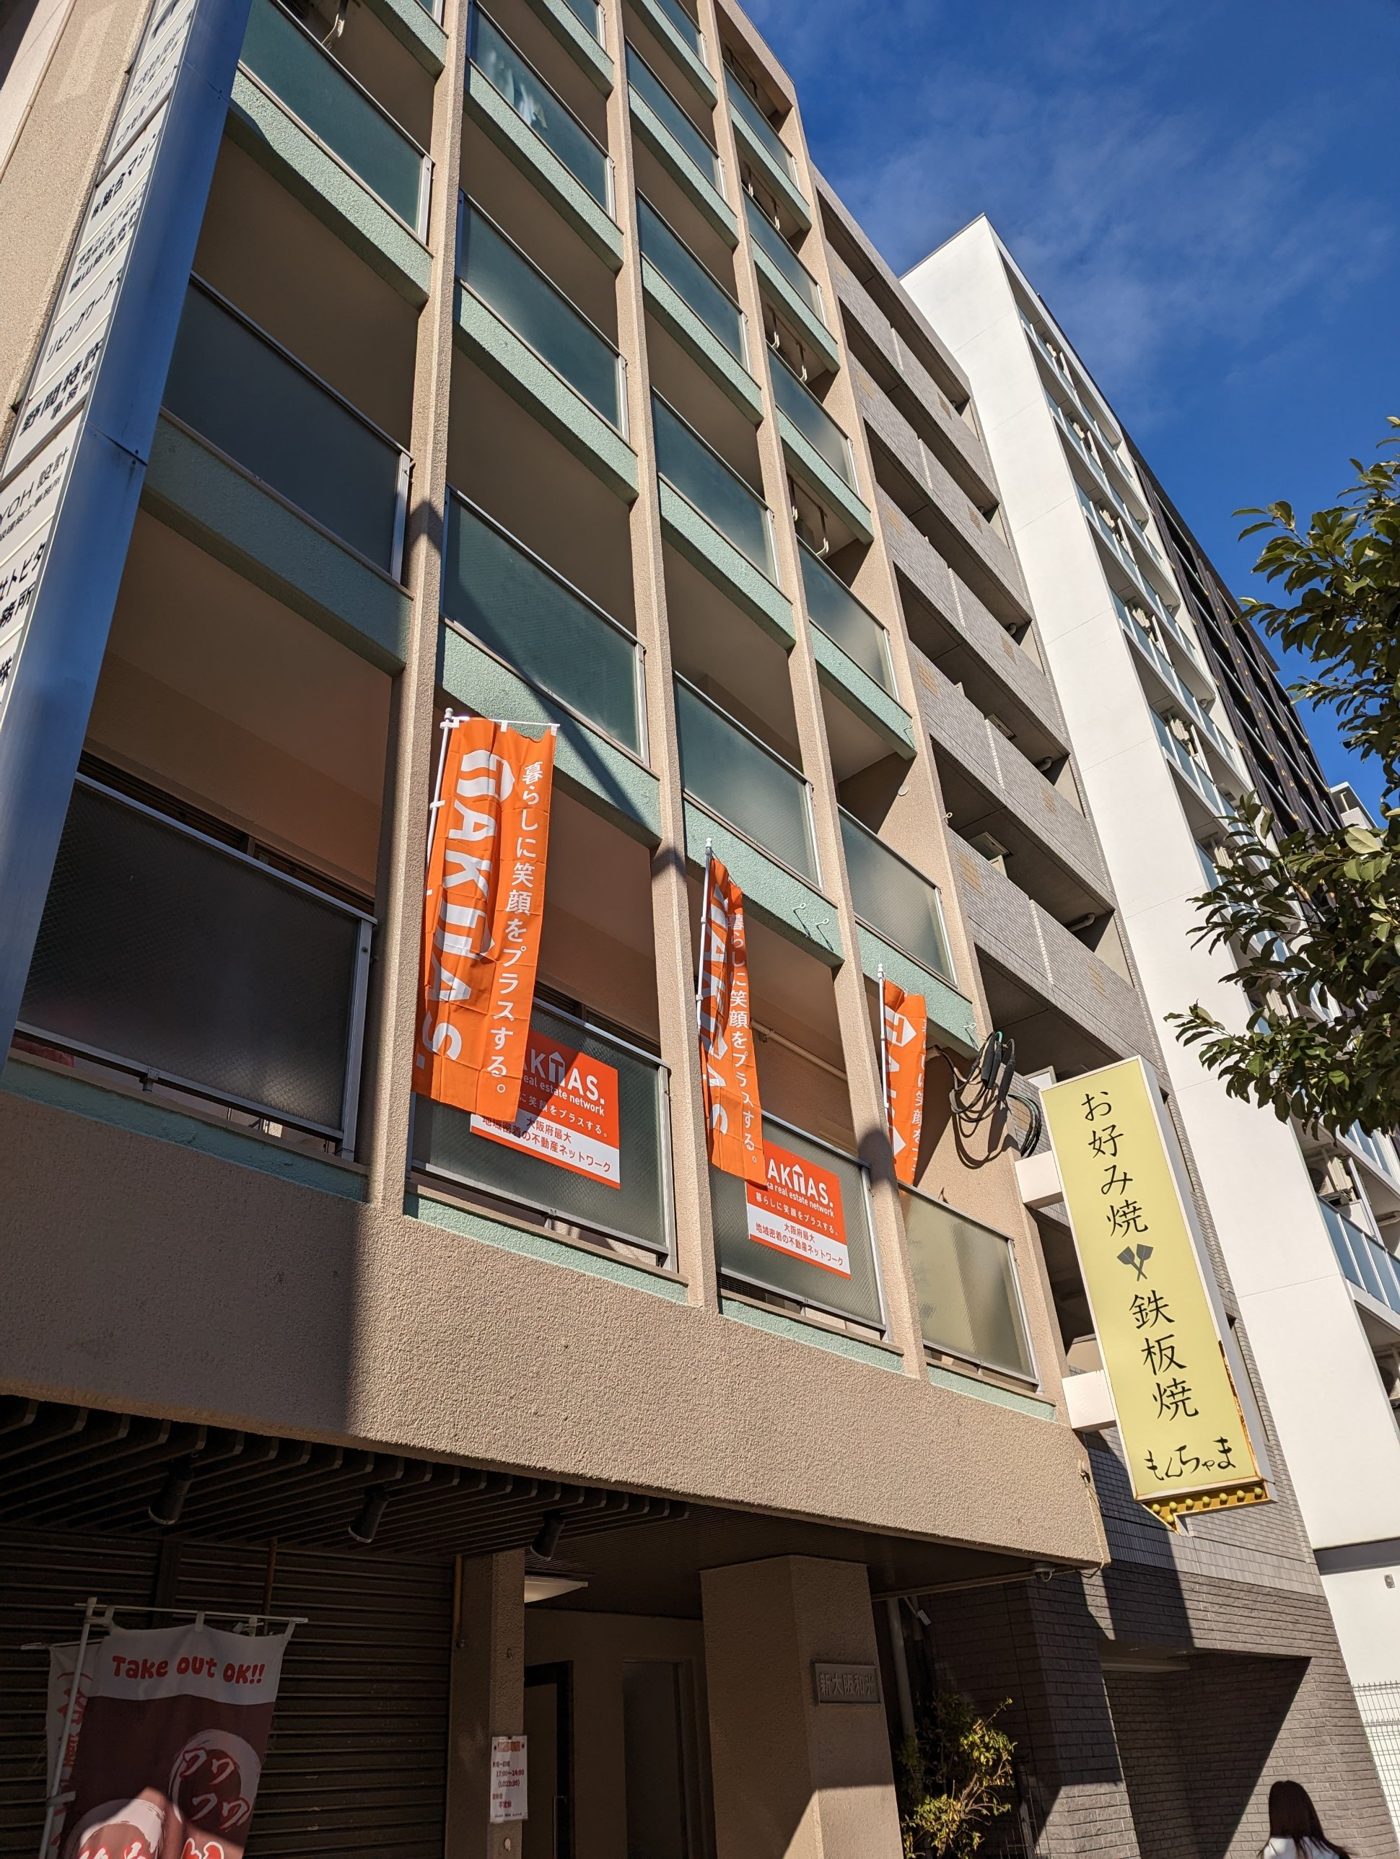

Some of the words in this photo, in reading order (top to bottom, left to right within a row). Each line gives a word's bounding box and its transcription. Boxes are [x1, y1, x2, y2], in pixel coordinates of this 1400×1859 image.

[486, 760, 544, 1094] 暮らしに笑顔をプラスする。
[539, 1082, 568, 1101] estate
[569, 1094, 606, 1117] network
[526, 1116, 572, 1144] 大阪府最大
[1081, 1091, 1149, 1238] お好み焼
[774, 1184, 788, 1197] real
[1128, 1289, 1200, 1422] 鉄板焼
[1143, 1436, 1237, 1481] もんちゃま
[112, 1655, 169, 1680] Take
